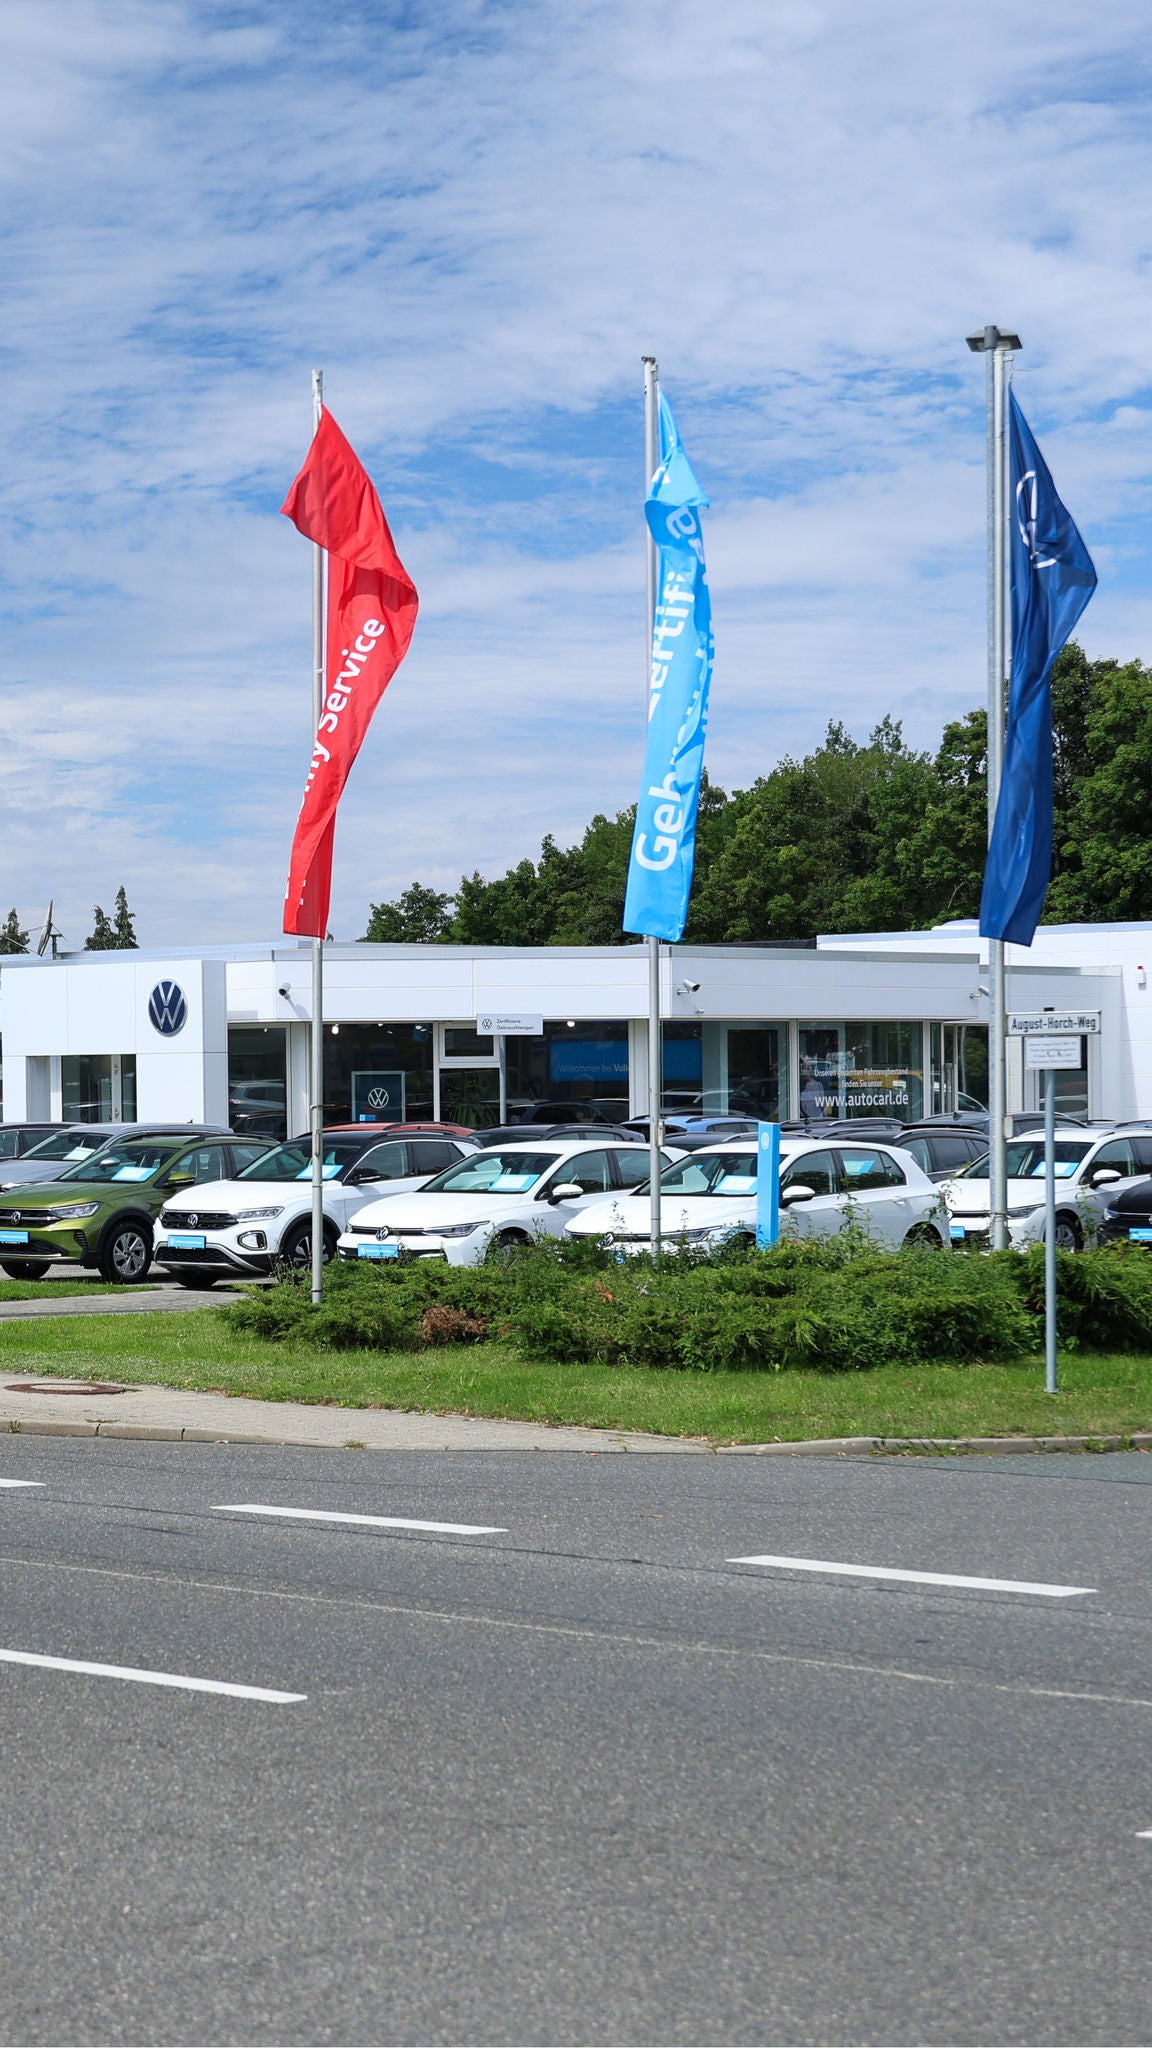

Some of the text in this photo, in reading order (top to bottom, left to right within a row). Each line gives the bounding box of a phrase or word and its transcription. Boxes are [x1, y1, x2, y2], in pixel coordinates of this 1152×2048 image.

[318, 618, 385, 733] Service
[149, 979, 188, 1037] VW
[1011, 1016, 1096, 1032] August-Horch-Weg
[368, 1087, 389, 1109] VW
[815, 1090, 909, 1108] www.autocarl.de
